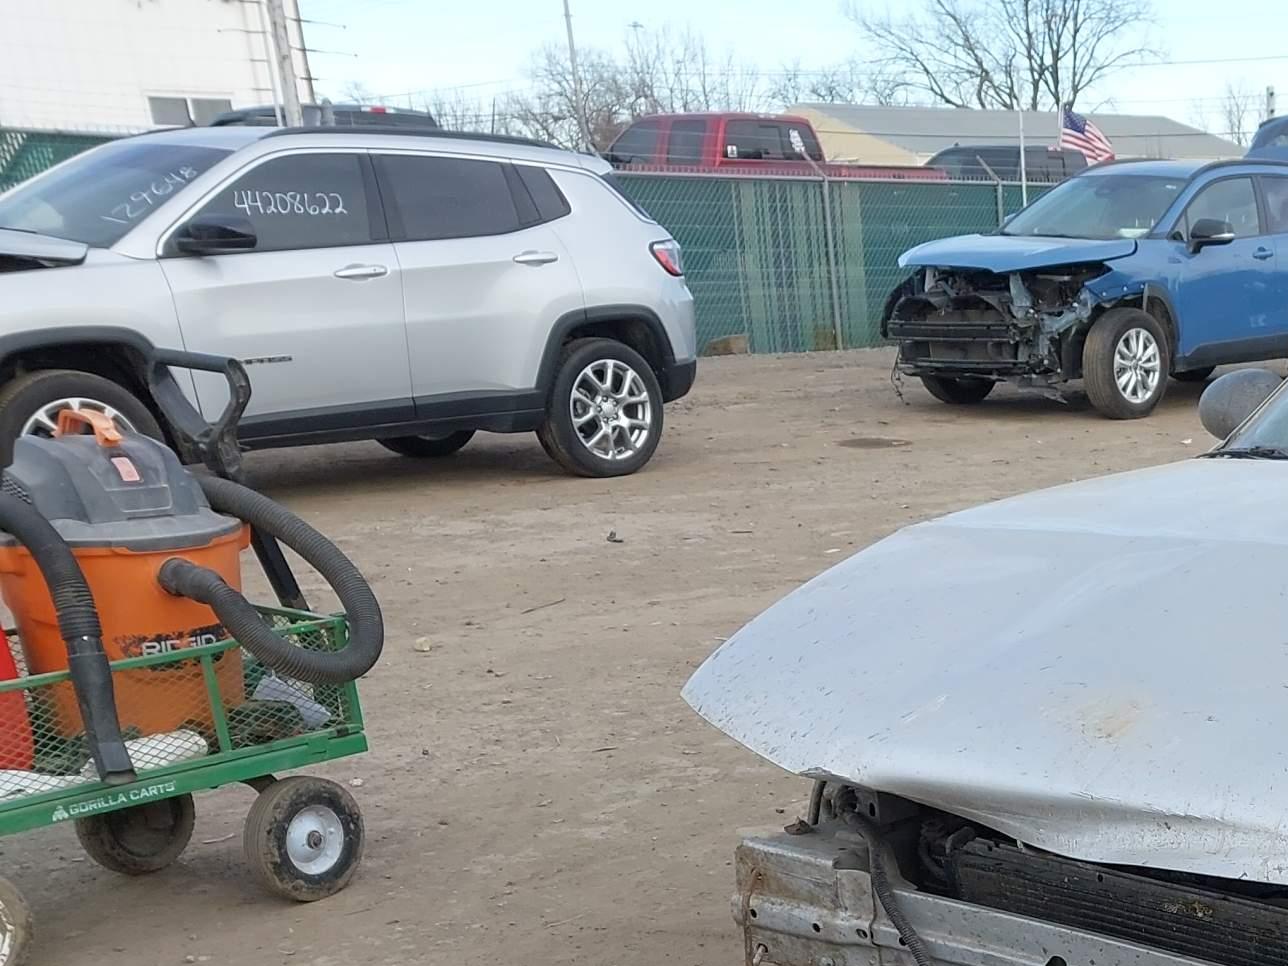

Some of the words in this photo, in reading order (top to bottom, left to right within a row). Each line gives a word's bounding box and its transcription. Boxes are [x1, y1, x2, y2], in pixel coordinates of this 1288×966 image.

[233, 189, 348, 217] 44208622
[68, 793, 128, 816] GORILLA
[129, 781, 176, 801] CARTS
